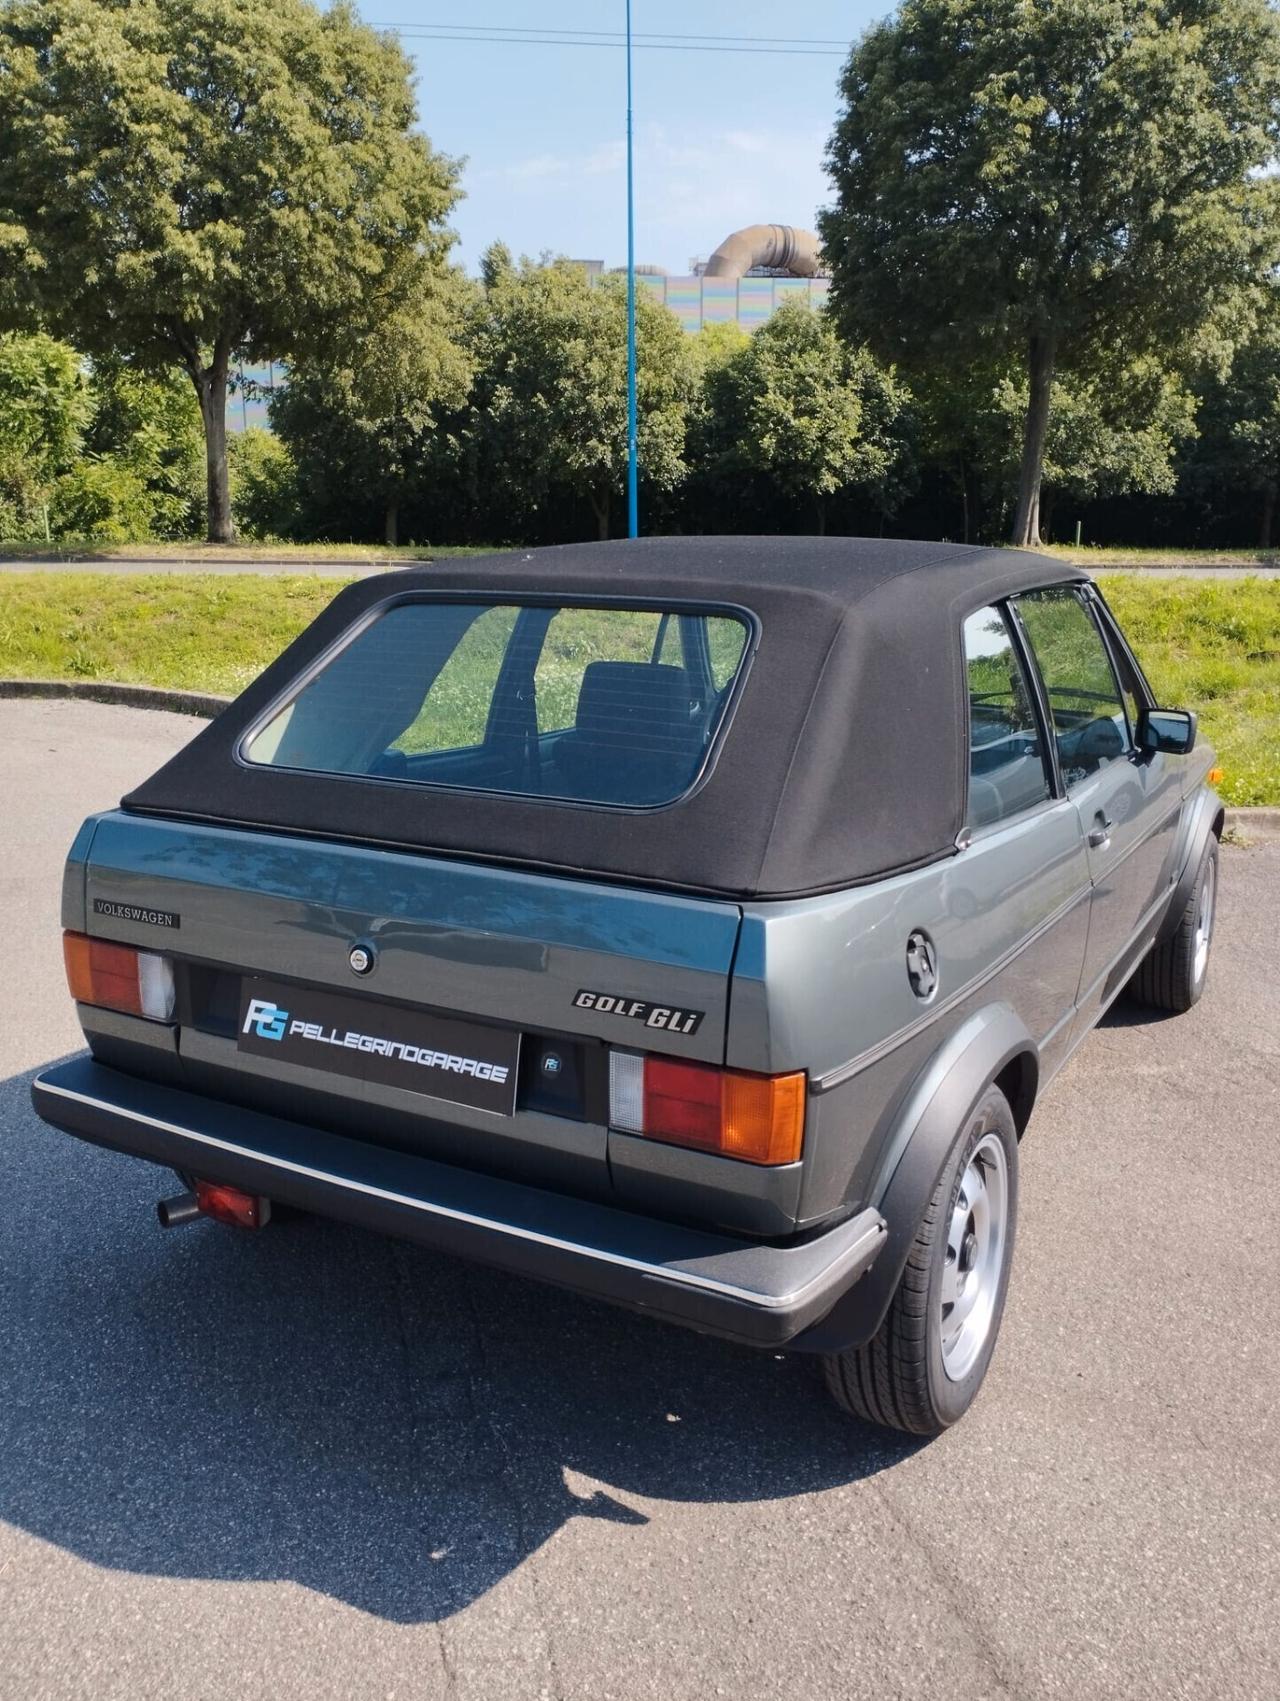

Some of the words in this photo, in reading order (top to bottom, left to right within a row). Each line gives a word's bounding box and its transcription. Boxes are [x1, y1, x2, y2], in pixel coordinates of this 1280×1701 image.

[97, 902, 172, 926] VOLKSWAGEN
[576, 992, 646, 1017] GOLF
[289, 1020, 509, 1084] PELLEGRINOGARAGE
